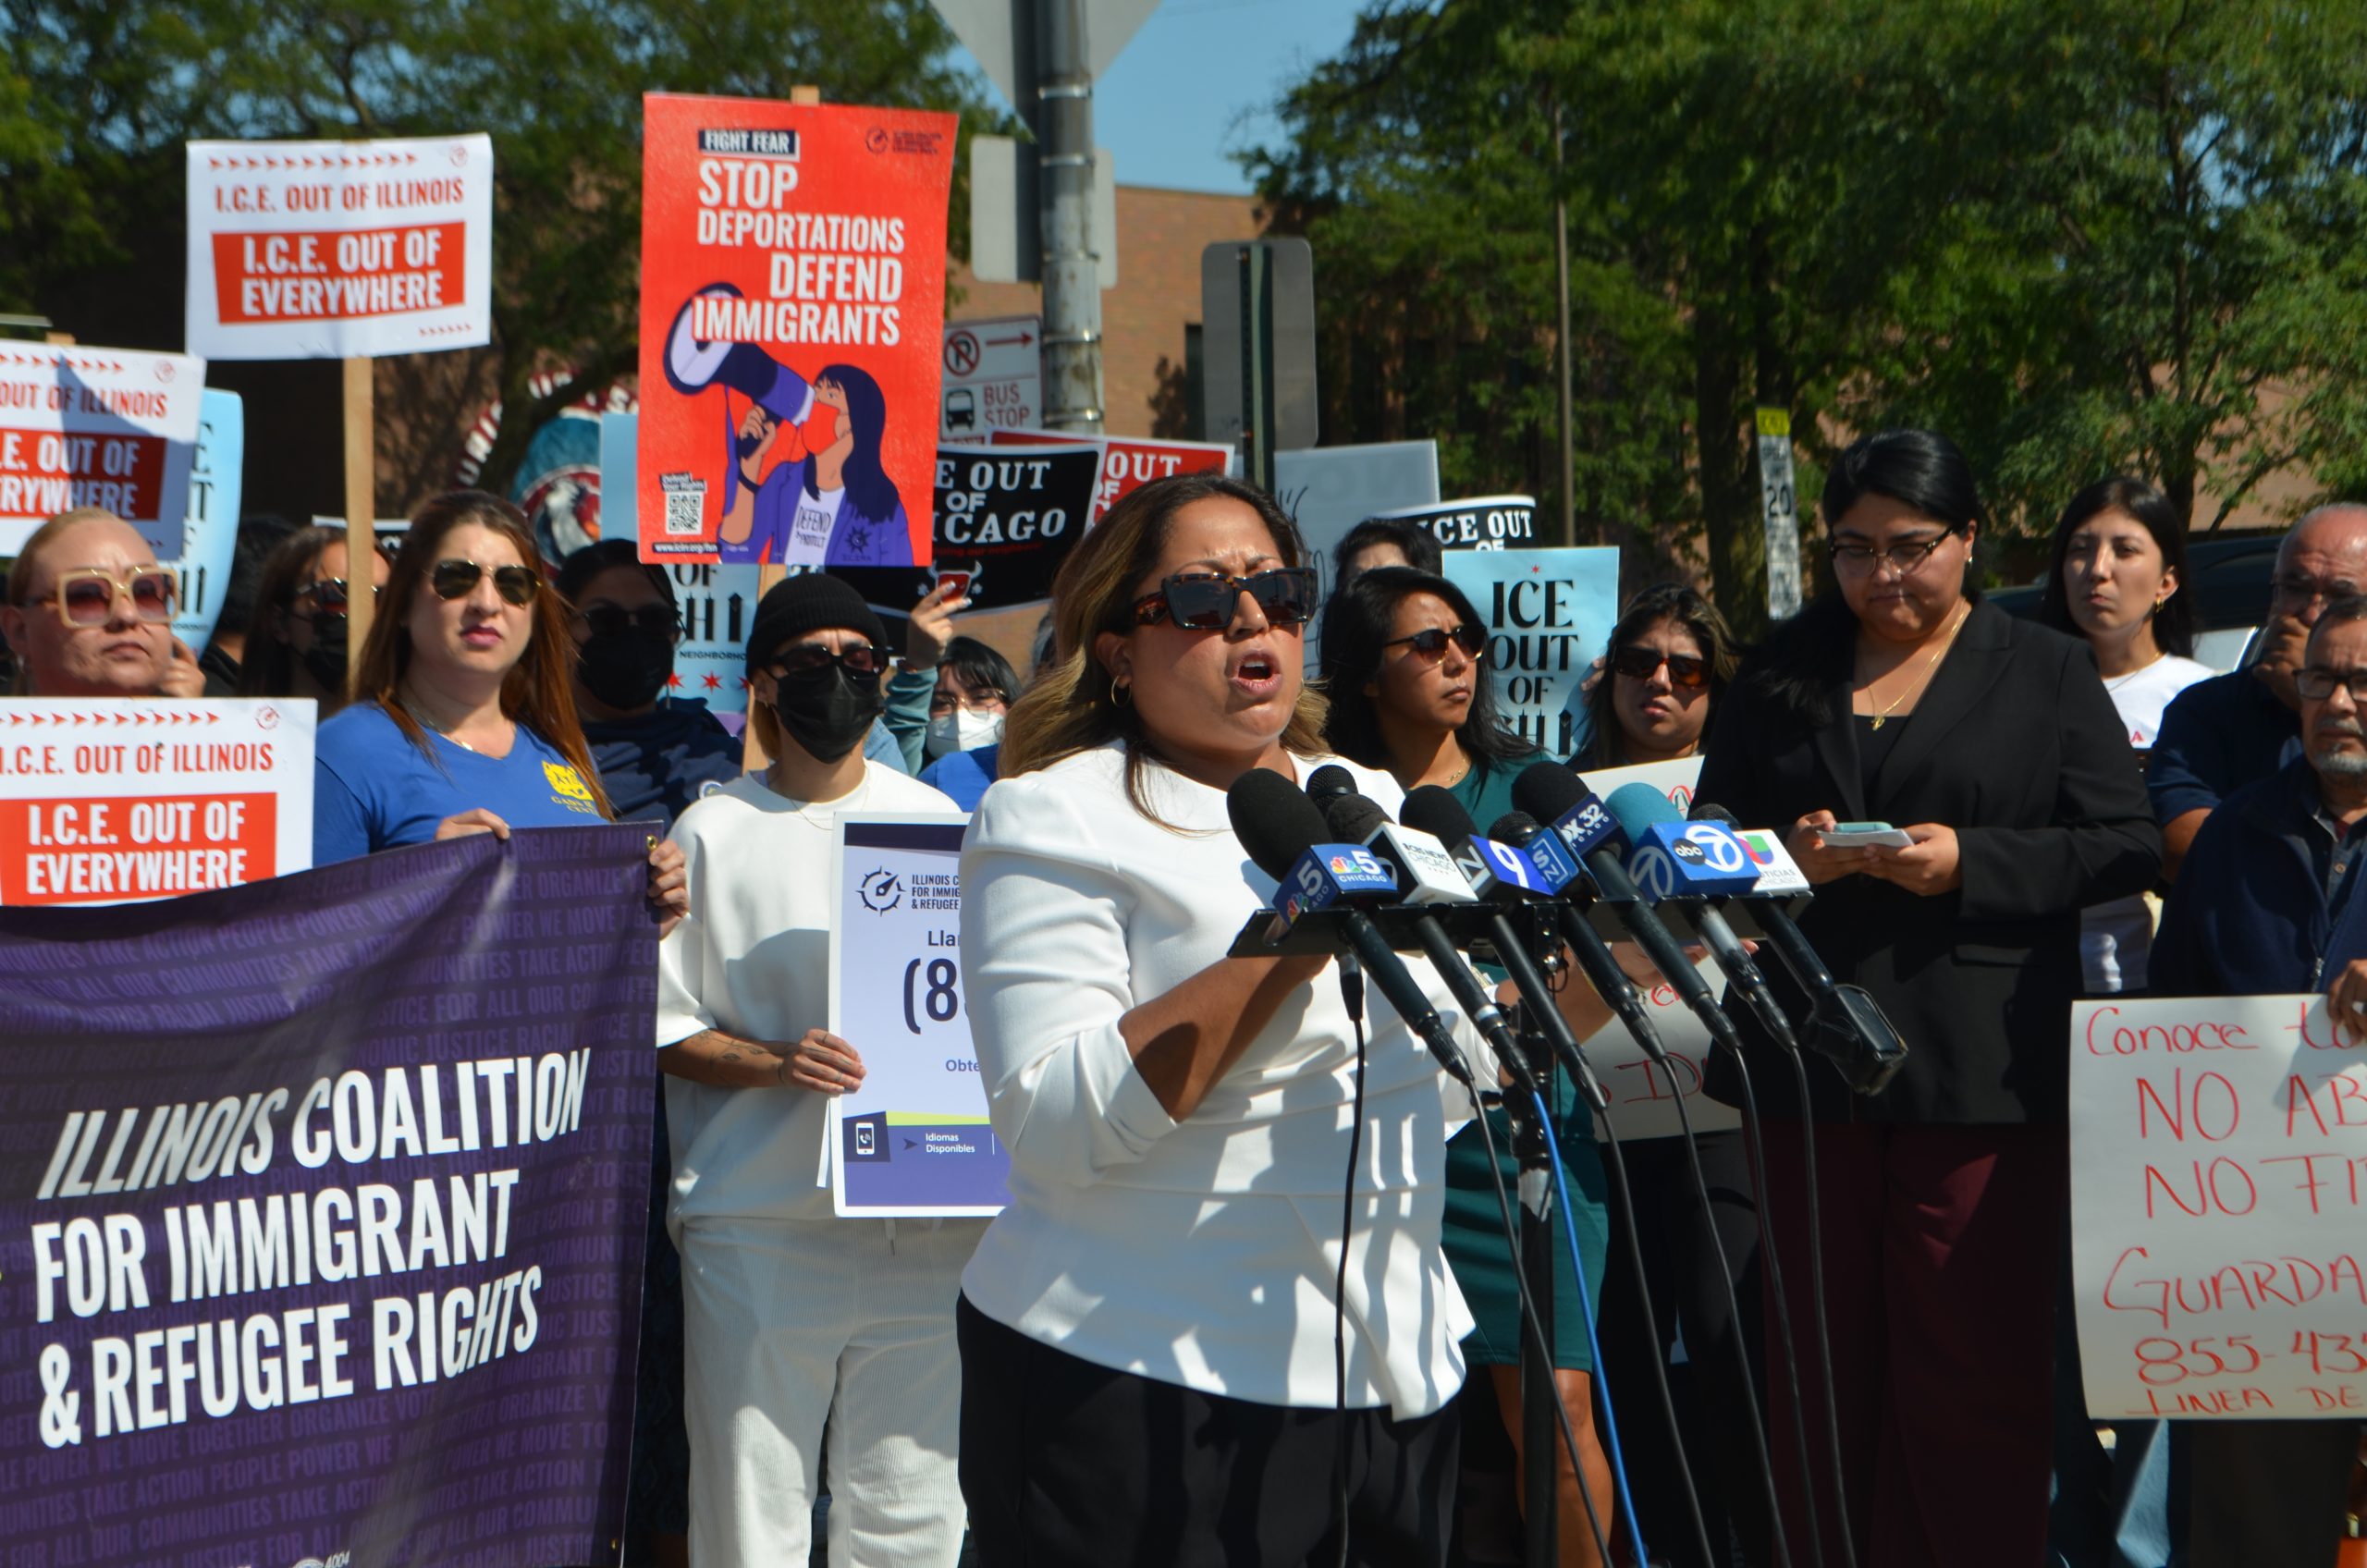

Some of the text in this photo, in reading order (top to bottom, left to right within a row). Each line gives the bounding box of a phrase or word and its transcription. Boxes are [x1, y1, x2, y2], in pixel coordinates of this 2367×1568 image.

[705, 130, 789, 153] FIGHT FEAR
[215, 177, 464, 213] I.C.E. OUT OF ILLINOIS
[699, 158, 798, 210] STOP
[697, 208, 905, 254] DEPORTATIONS
[243, 228, 442, 274] I.C.E. OUT OF
[241, 271, 443, 316] EVERYWHERE
[769, 251, 902, 303] DEFEND
[693, 298, 901, 346] IMMIGRANTS
[0, 383, 168, 418] OUT OF ILLINOIS
[984, 383, 1020, 406] BUS
[985, 405, 1031, 428] STOP
[37, 435, 97, 475] OUT
[104, 440, 141, 478] OF
[969, 460, 1051, 491] OUT
[1106, 450, 1183, 483] OUT
[0, 477, 138, 519] RYWHERE
[946, 492, 987, 513] OF
[1767, 484, 1791, 518] 20
[1417, 509, 1532, 545] CE OUT
[675, 564, 717, 586] OF
[1491, 580, 1574, 629] ICE
[1490, 634, 1578, 672] OUT
[1508, 676, 1553, 705] OF
[1500, 709, 1572, 755] HI
[75, 745, 127, 775] OUT
[136, 744, 165, 774] OF
[173, 742, 274, 773] ILLINOIS
[28, 801, 246, 846] I.C.E. OUT OF
[1578, 803, 1604, 828] 32
[1352, 851, 1382, 875] 5
[1489, 839, 1530, 888] 9
[1674, 845, 1703, 858] abc
[26, 849, 248, 895] EVERYWHERE
[538, 867, 622, 900] ORGANIZE
[912, 874, 950, 886] ILLINOIS
[1296, 861, 1323, 897] 5
[1339, 874, 1388, 883] CHICAGO
[912, 887, 930, 898] FOR
[912, 899, 960, 910] & REFUGEE
[88, 895, 404, 965] TAKE ACTION PEOPLE POWER WE
[540, 909, 563, 937] WE
[567, 905, 616, 936] MOVE
[75, 942, 354, 1000] ALL OUR COMMUNITIES TAKE
[518, 947, 560, 977] TAKE
[150, 999, 226, 1031] RACIAL
[434, 985, 565, 1023] FOR ALL OUR
[903, 958, 969, 1035] (8
[425, 1027, 509, 1060] JUSTICE
[2087, 1006, 2260, 1056] Conoce
[2136, 1068, 2239, 1141] NO
[36, 1047, 591, 1201] ILLINOIS COALITION
[926, 1133, 959, 1142] Idiomas
[926, 1144, 975, 1155] Disponibles
[2145, 1154, 2367, 1219] NO FI
[31, 1212, 150, 1323] FOR
[165, 1169, 520, 1305] IMMIGRANT
[2103, 1246, 2367, 1330] GUARDA
[39, 1265, 543, 1450] & REFUGEE RIGHTS
[2134, 1331, 2367, 1385] 855-43
[2124, 1386, 2364, 1416] LINEA DE
[26, 1445, 90, 1486] POWER
[96, 1439, 123, 1474] WE
[129, 1433, 182, 1468] MOVE
[187, 1413, 287, 1455] TOGETHER
[289, 1394, 389, 1439] ORGANIZE
[82, 1481, 129, 1517] TAKE
[135, 1466, 205, 1507] ACTION
[210, 1452, 282, 1494] PEOPLE
[288, 1439, 360, 1478] POWER
[365, 1434, 393, 1465] WE
[498, 1384, 585, 1423] ORGANIZE
[55, 1533, 87, 1567] ALL
[92, 1523, 133, 1560] OUR
[140, 1494, 274, 1550] COMMUNITIES
[277, 1484, 328, 1523] TAKE
[496, 1430, 517, 1461] WE
[520, 1422, 570, 1456] MOVE
[265, 1531, 303, 1567] FOR
[472, 1469, 509, 1504] TAKE
[512, 1460, 584, 1494] ACTION
[446, 1516, 470, 1550] ALL
[474, 1505, 508, 1538] OUR
